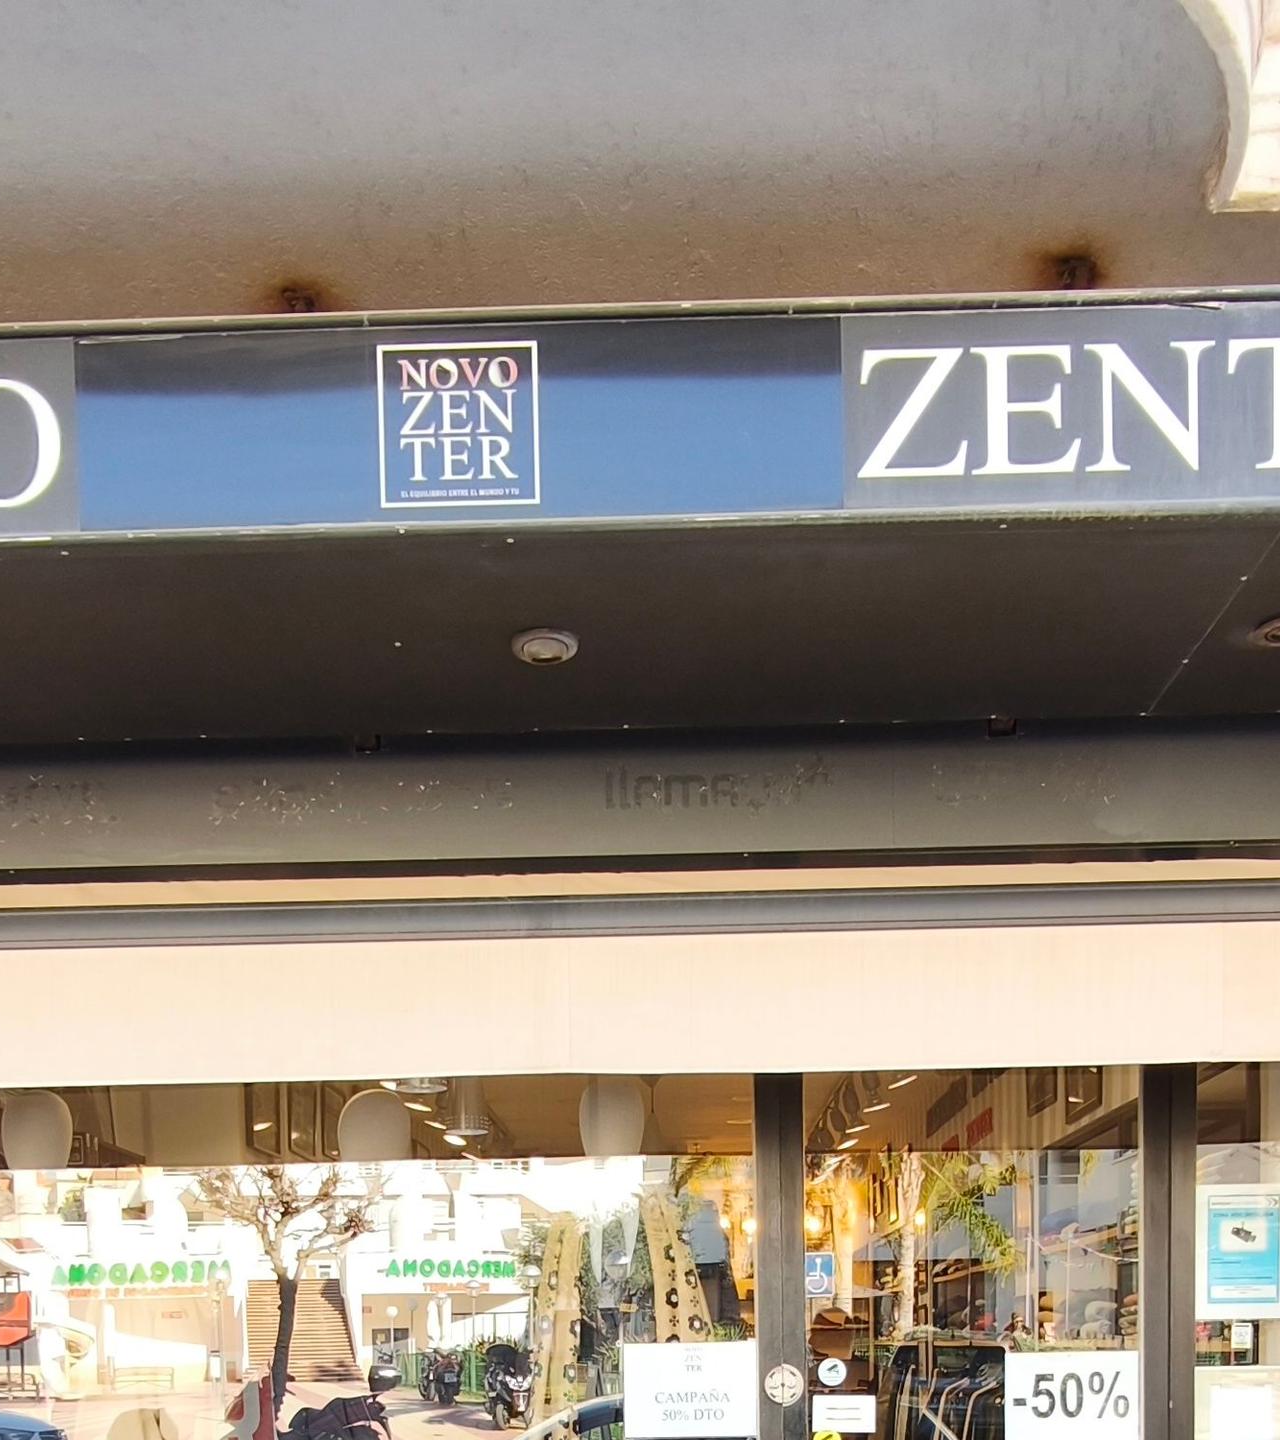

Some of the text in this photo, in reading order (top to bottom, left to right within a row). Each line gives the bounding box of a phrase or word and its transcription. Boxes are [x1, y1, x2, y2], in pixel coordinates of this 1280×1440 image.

[397, 356, 519, 390] NOVO
[399, 389, 517, 435] ZEN
[399, 435, 519, 481] TER
[654, 1388, 731, 1404] CAMPAÑA
[661, 1408, 725, 1422] 50% DTO
[1012, 1371, 1131, 1420] -50%
